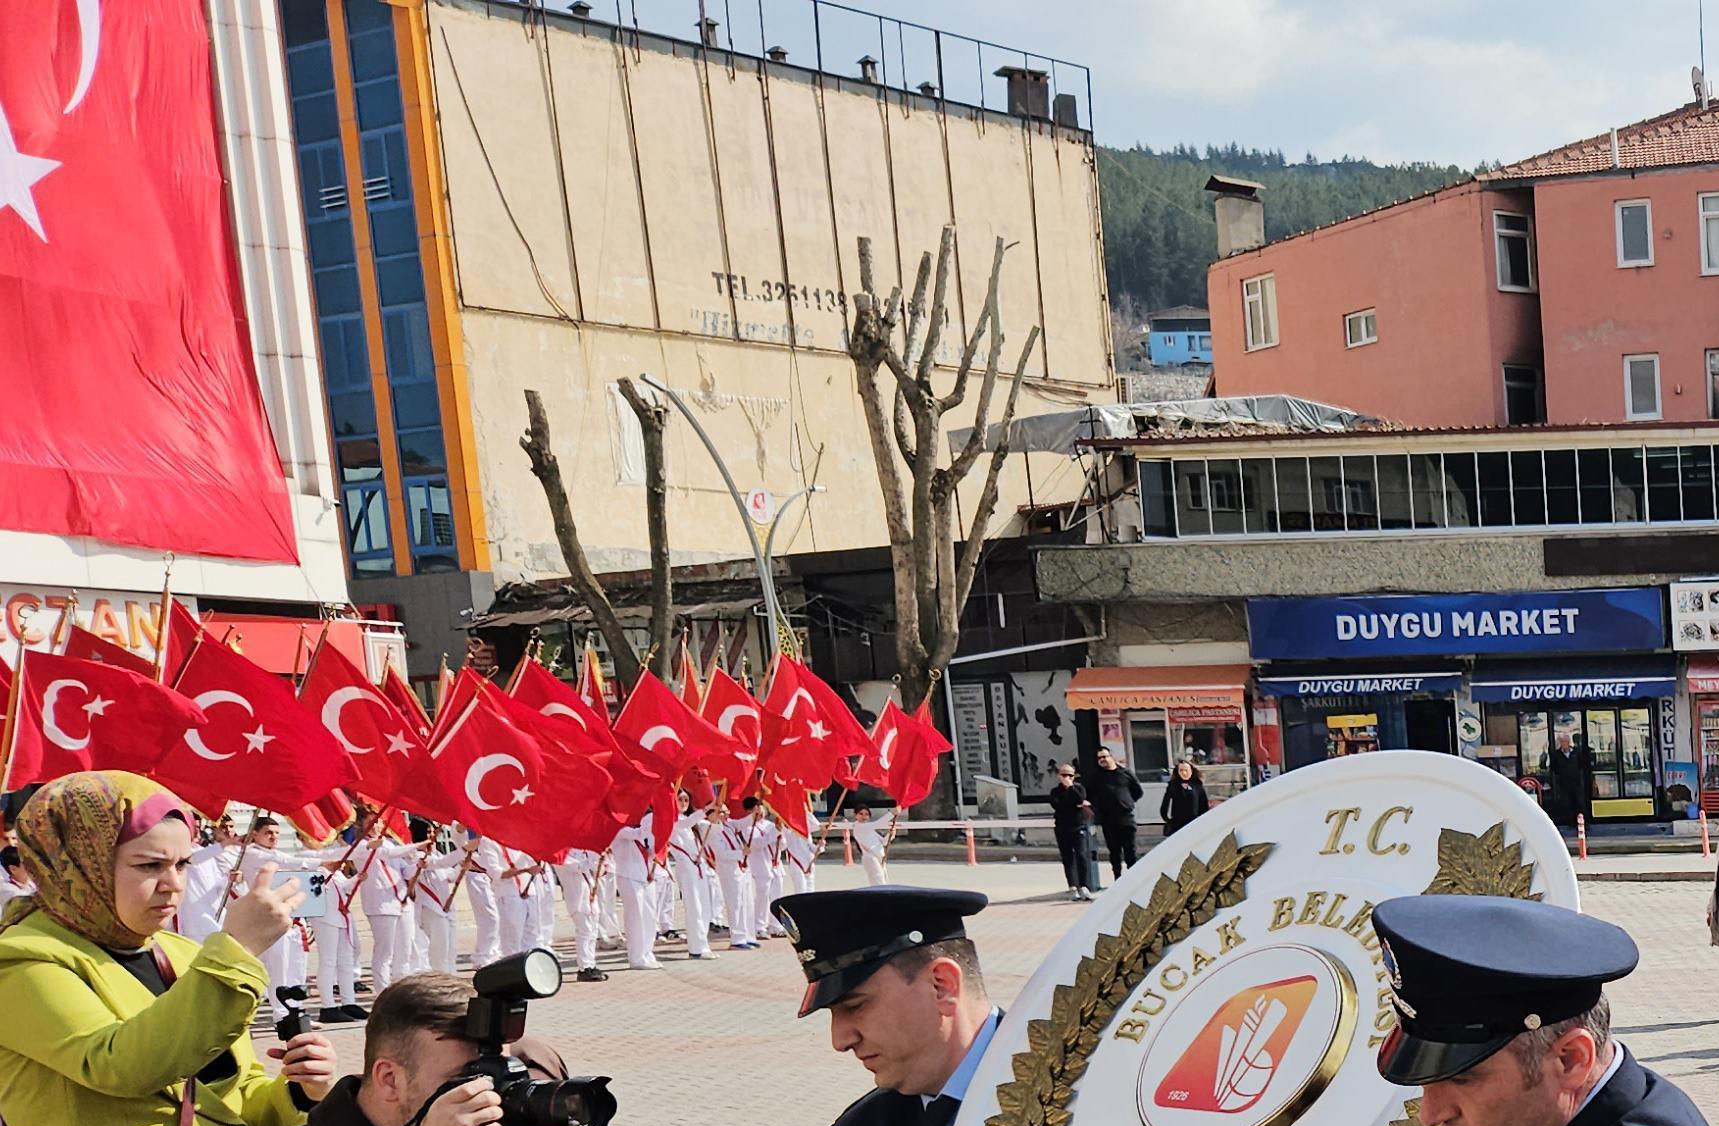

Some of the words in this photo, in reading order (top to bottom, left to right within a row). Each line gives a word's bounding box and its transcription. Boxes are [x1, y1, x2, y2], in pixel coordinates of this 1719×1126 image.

[1336, 612, 1442, 642] DUYGU
[1452, 607, 1580, 638] MARKET
[1298, 679, 1355, 694] DUYGU
[1357, 678, 1424, 693] MARKET
[1510, 684, 1566, 700] DUYGU
[1567, 682, 1636, 698] MARKET
[1113, 915, 1247, 1045] BUCAK
[1167, 1088, 1190, 1102] 1926
